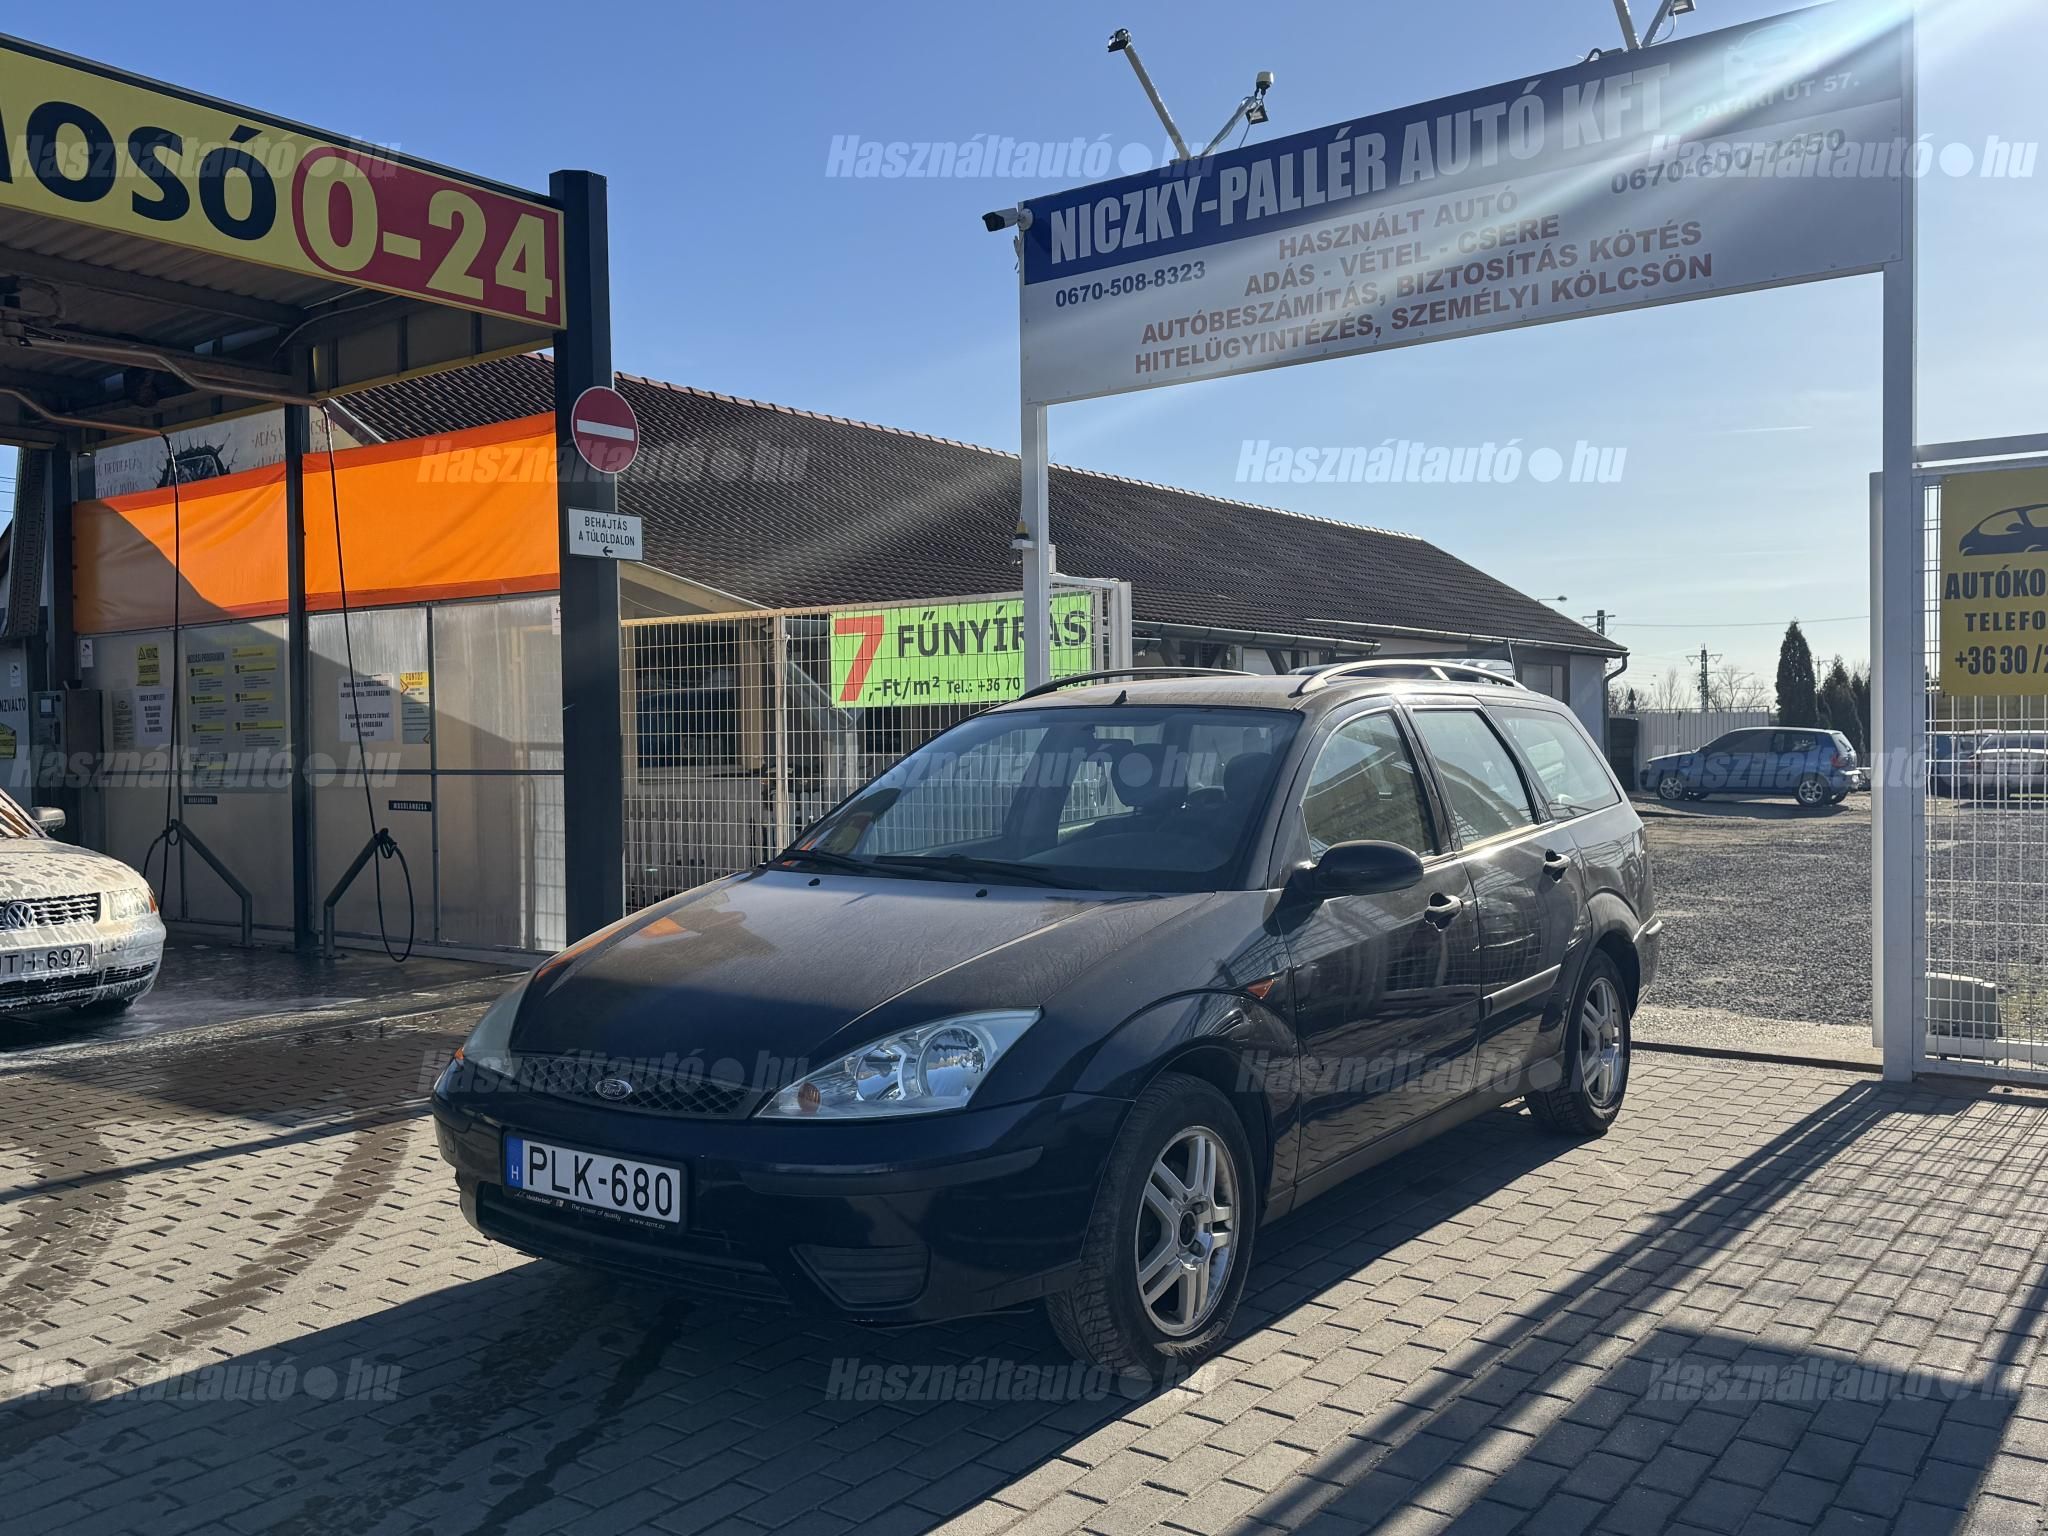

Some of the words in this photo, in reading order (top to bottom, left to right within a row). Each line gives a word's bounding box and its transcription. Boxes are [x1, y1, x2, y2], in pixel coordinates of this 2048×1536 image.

[1823, 71, 1861, 93] 57.
[1051, 127, 1386, 264] NICZKY-PALLÉR
[1400, 83, 1545, 186] AUTÓ
[1562, 63, 1670, 150] KFT
[0, 100, 277, 240] OSÓ
[302, 156, 553, 315] 0-24
[1279, 209, 1425, 260] HASZNÁLT
[1435, 186, 1518, 228] AUTÓ
[1056, 261, 1206, 307] 0670-508-8323
[1141, 281, 1387, 345] AUTÓBESZÁMÍTÁS,
[1396, 238, 1579, 298] BIZTOSÍTÁS
[1590, 220, 1703, 259] KÖTÉS
[1244, 256, 1315, 296] ADÁS
[1341, 242, 1430, 278] VÉTEL
[1458, 214, 1560, 256] CSERE
[1135, 312, 1382, 374] HITELÜGYINTÉZÉS,
[1391, 281, 1540, 331] SZEMÉLYI
[1552, 253, 1713, 301] KÖLCSÖN
[578, 531, 584, 541] A
[586, 530, 635, 547] TÚLOLDALON
[584, 516, 628, 532] BEHAJTÁS
[1944, 564, 2048, 600] AUTÓKO
[831, 614, 884, 702] 7
[978, 678, 1001, 693] +36
[0, 946, 86, 975] TH-692
[511, 1165, 519, 1181] H
[529, 1146, 673, 1217] PLK-680
